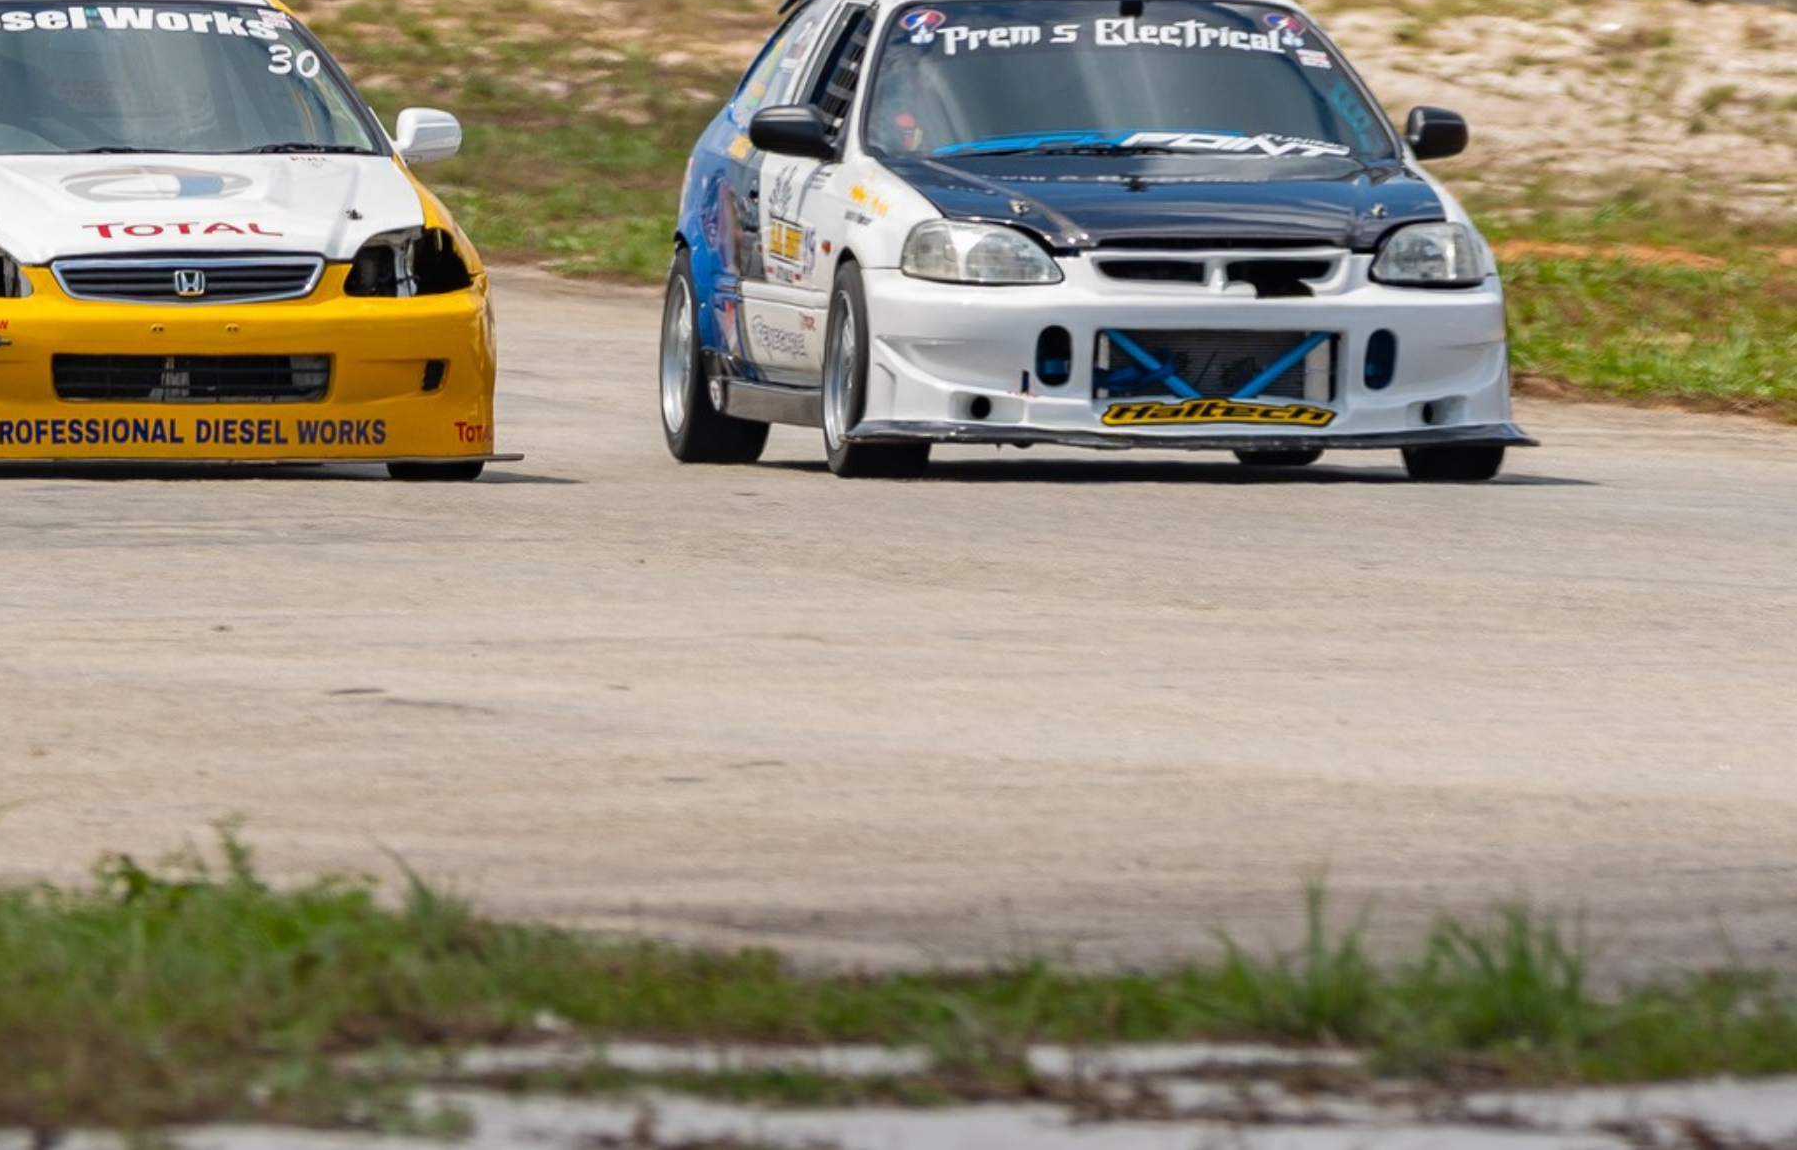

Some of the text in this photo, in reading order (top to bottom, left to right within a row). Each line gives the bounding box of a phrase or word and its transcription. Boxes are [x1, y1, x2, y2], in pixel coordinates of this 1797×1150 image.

[97, 6, 280, 41] Works
[268, 43, 321, 79] 30
[83, 221, 284, 239] TOTAL
[1111, 401, 1328, 421] Haltech
[196, 419, 288, 445] DIESEL
[296, 419, 387, 444] WORKS
